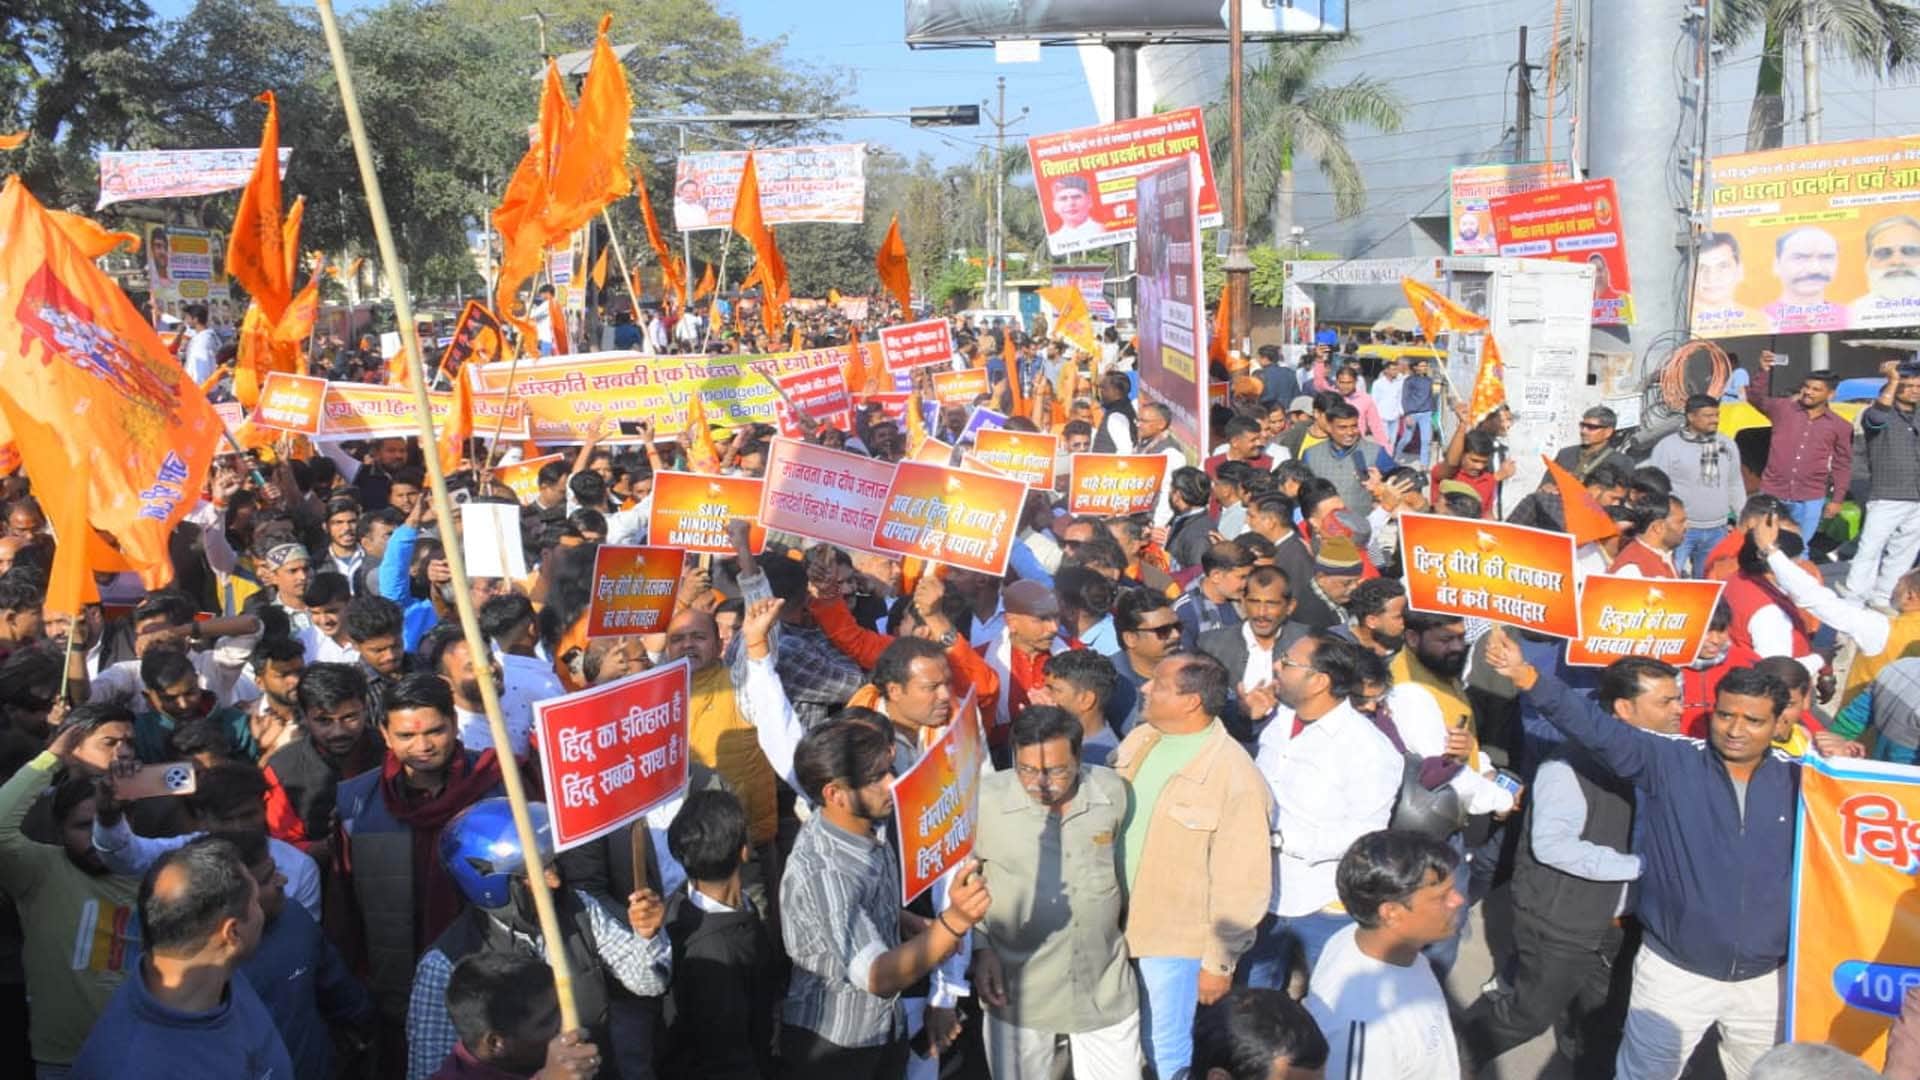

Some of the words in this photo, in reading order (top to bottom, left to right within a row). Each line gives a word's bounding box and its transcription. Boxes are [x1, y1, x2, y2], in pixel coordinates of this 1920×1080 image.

[518, 372, 587, 396] संस्कृति
[591, 364, 649, 390] सबकी
[730, 399, 775, 419] Bangl
[678, 517, 724, 532] HINDUS
[698, 503, 729, 518] SAVE
[669, 531, 735, 549] BANGLADE
[1413, 546, 1447, 578] हिन्दू
[1449, 549, 1480, 576] वीरों
[1483, 553, 1505, 579] की
[1507, 562, 1563, 593] ललकार
[1436, 583, 1458, 608] बंद
[1461, 586, 1490, 610] करो
[1494, 593, 1548, 624] नरसंहार
[557, 725, 597, 763] हिंदू
[595, 721, 618, 750] का
[620, 702, 671, 746] इतिहास
[560, 772, 600, 809] हिंदू
[598, 752, 636, 796] सबके
[639, 745, 669, 779] साथ
